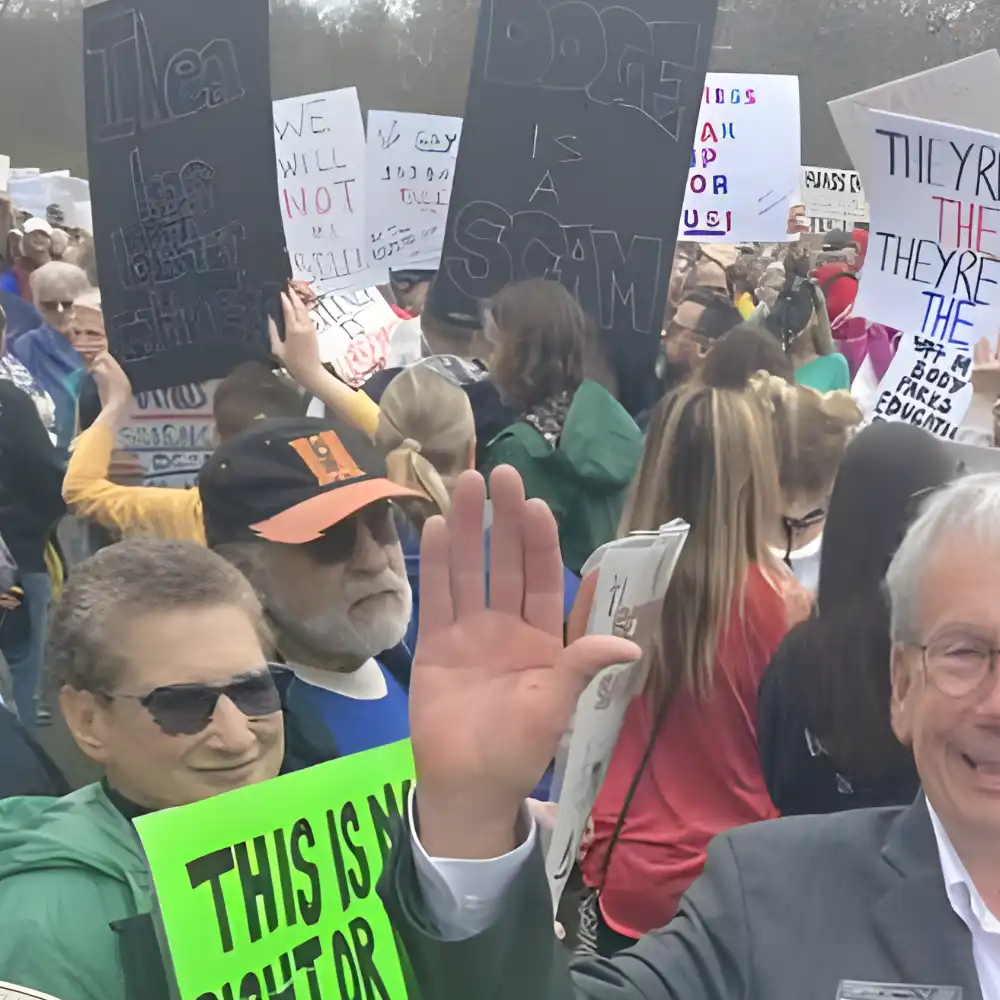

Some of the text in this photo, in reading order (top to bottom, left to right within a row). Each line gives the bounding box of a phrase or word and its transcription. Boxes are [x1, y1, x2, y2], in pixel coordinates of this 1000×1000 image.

[531, 123, 584, 163] IS
[283, 178, 356, 219] NOT
[529, 170, 559, 205] A
[932, 195, 1000, 252] THE
[445, 200, 663, 334] SCAM
[921, 290, 976, 346] THE
[896, 375, 952, 414] PARKS
[910, 359, 967, 394] BODY
[185, 817, 322, 954] THIS
[325, 800, 372, 913] IS
